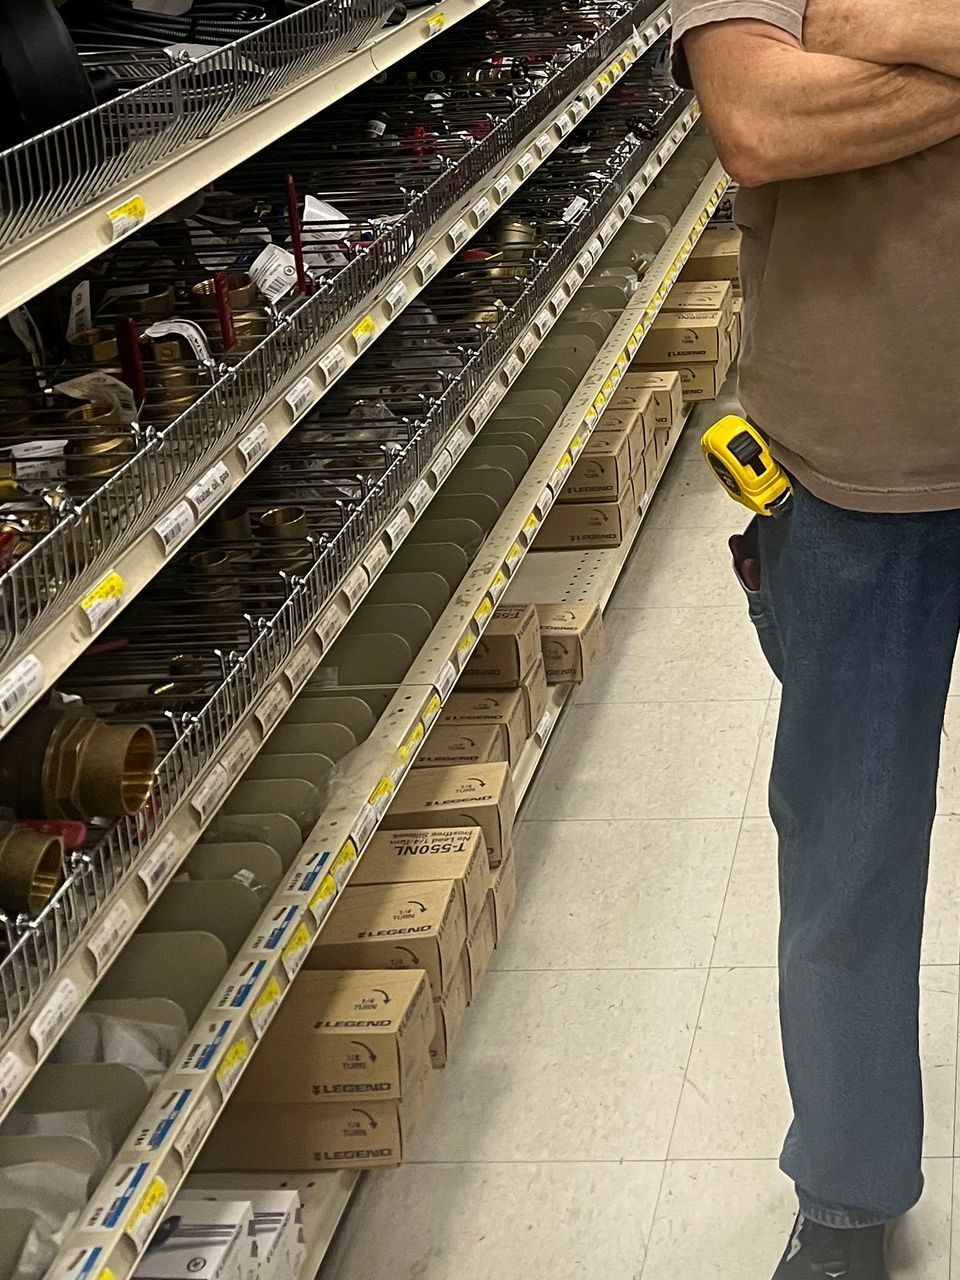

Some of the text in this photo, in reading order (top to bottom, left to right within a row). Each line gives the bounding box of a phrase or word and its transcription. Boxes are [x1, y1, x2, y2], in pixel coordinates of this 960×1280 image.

[434, 836, 457, 844] Lead
[458, 835, 472, 843] No
[394, 842, 466, 857] T-550NL
[366, 925, 432, 938] LEGEND
[322, 1019, 392, 1029] LEGEND
[323, 1082, 392, 1094] LEGEND
[323, 1148, 393, 1161] LEGEND
